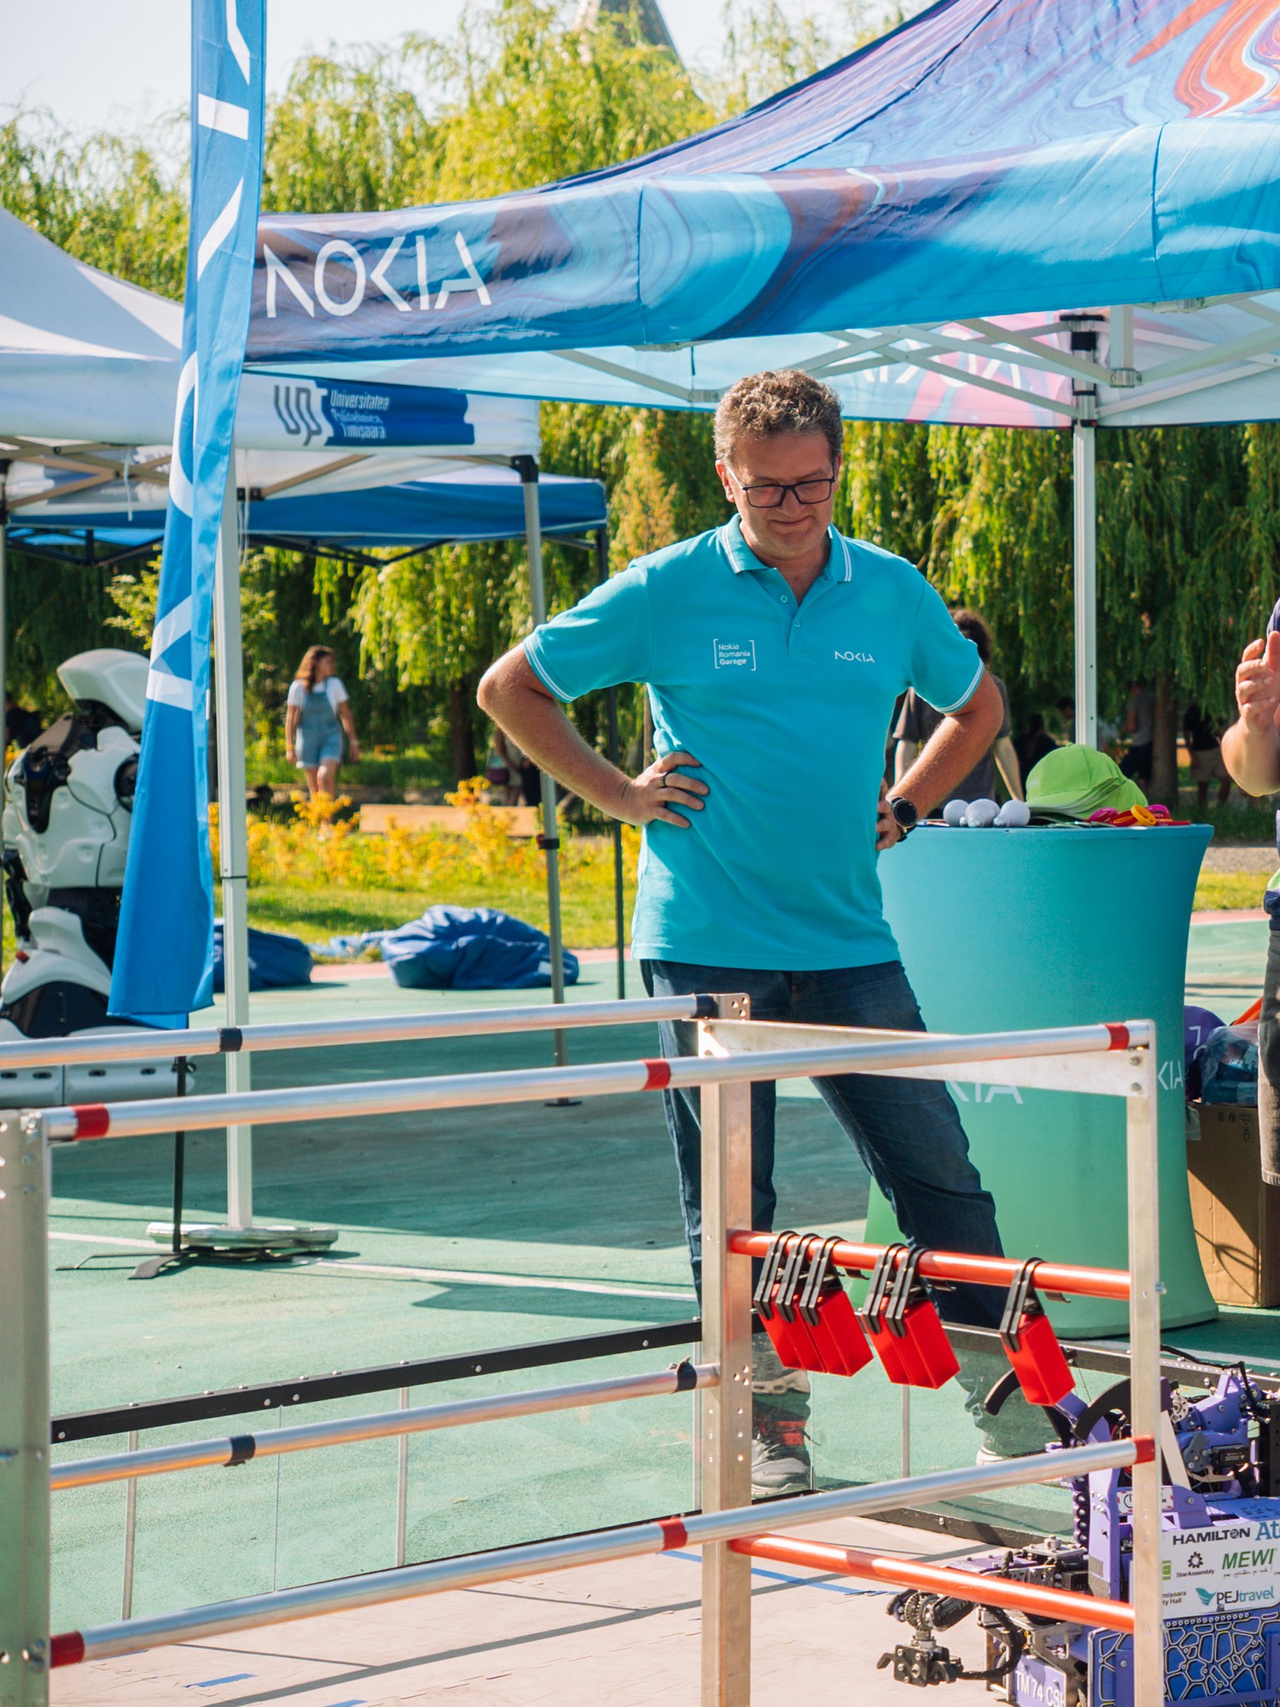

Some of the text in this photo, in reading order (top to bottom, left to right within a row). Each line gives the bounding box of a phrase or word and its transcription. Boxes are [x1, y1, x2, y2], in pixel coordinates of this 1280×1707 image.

[263, 230, 492, 318] NOKIA
[330, 388, 390, 411] Universitatea
[718, 643, 739, 651] Nokia
[718, 650, 751, 658] Romania
[834, 650, 876, 663] NOKIA
[719, 658, 747, 666] Garage
[1172, 1528, 1251, 1546] HAMILTON
[1221, 1548, 1275, 1570] MEWI
[1176, 1567, 1215, 1578] StarAssembly
[1170, 1597, 1182, 1605] Hall
[1015, 1670, 1031, 1696] TM
[1032, 1678, 1044, 1702] 74
